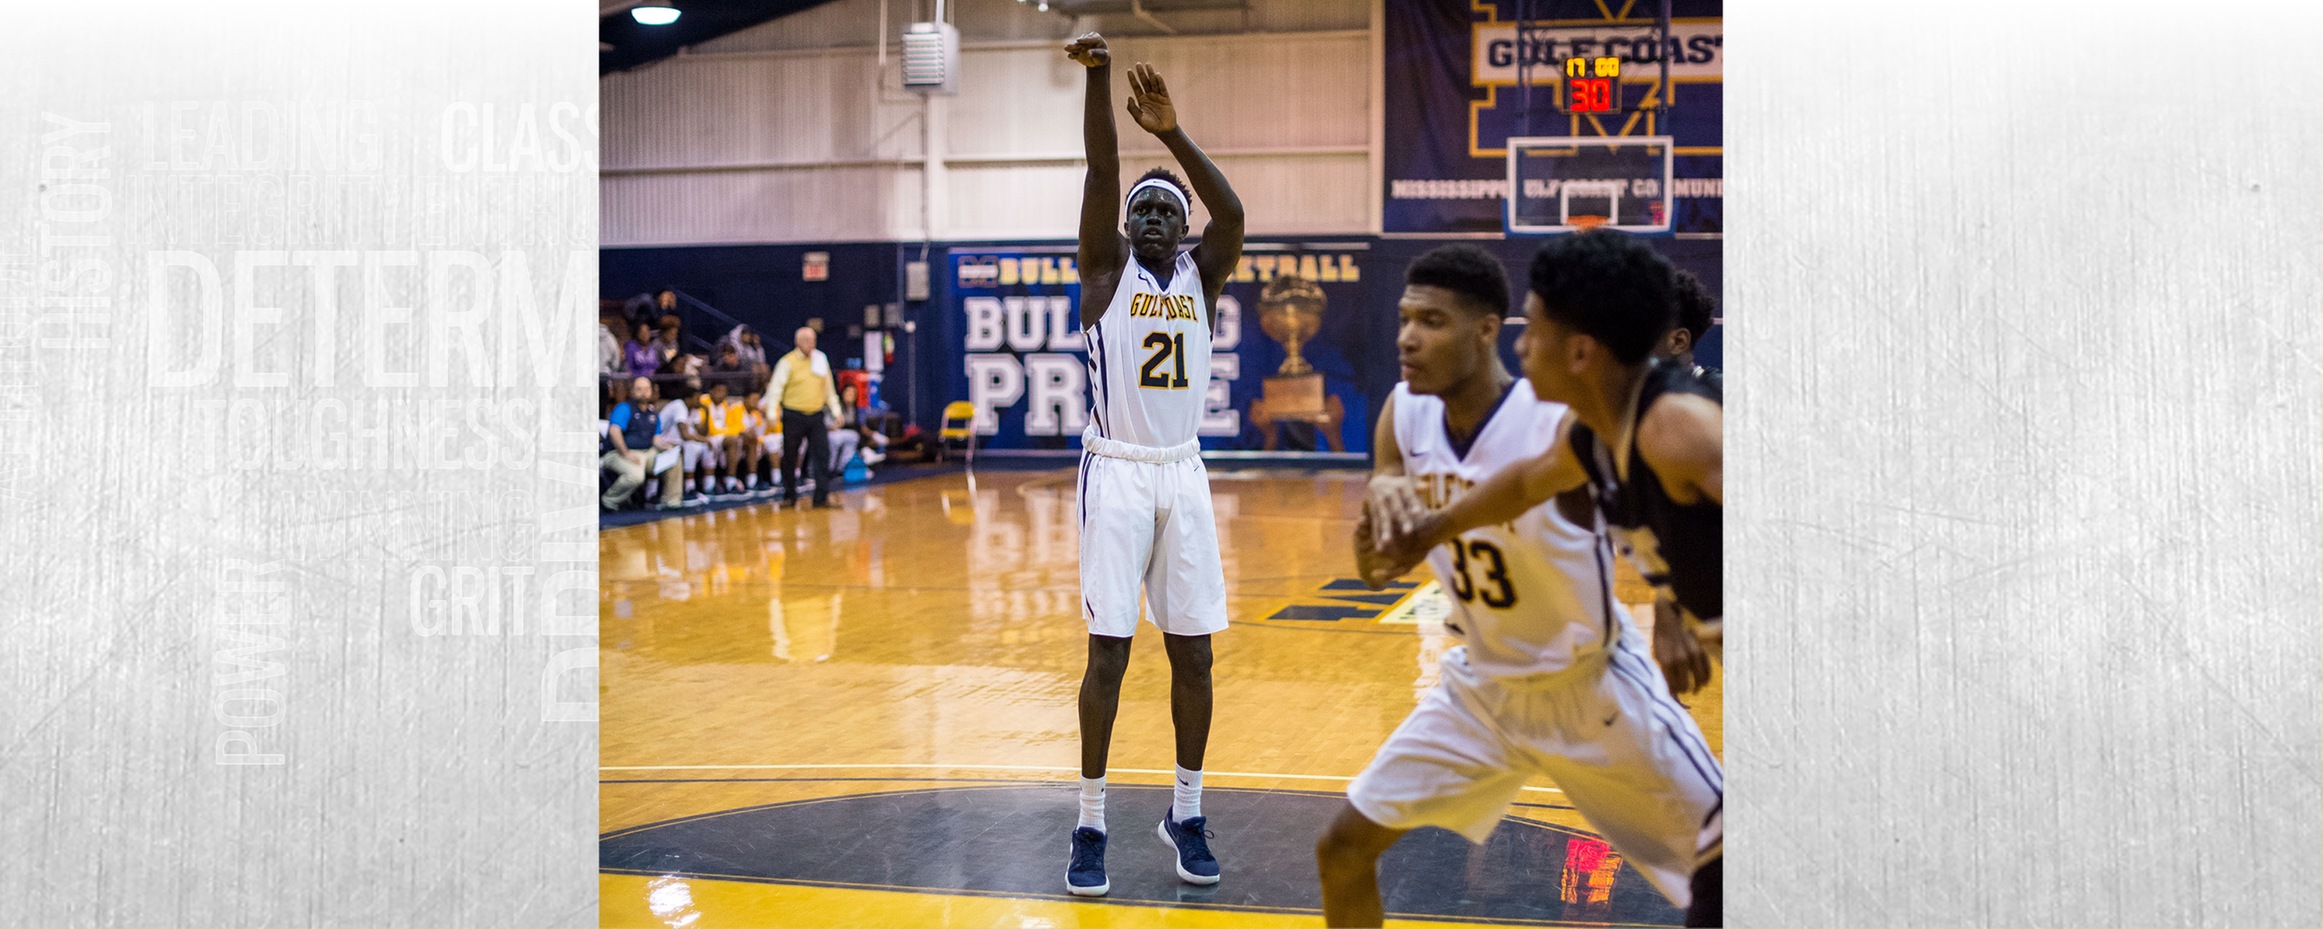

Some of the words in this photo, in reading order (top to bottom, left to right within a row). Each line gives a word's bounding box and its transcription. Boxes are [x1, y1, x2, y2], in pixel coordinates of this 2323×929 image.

[1570, 78, 1611, 112] 30
[1138, 331, 1189, 390] 21
[1449, 537, 1518, 610] 33
